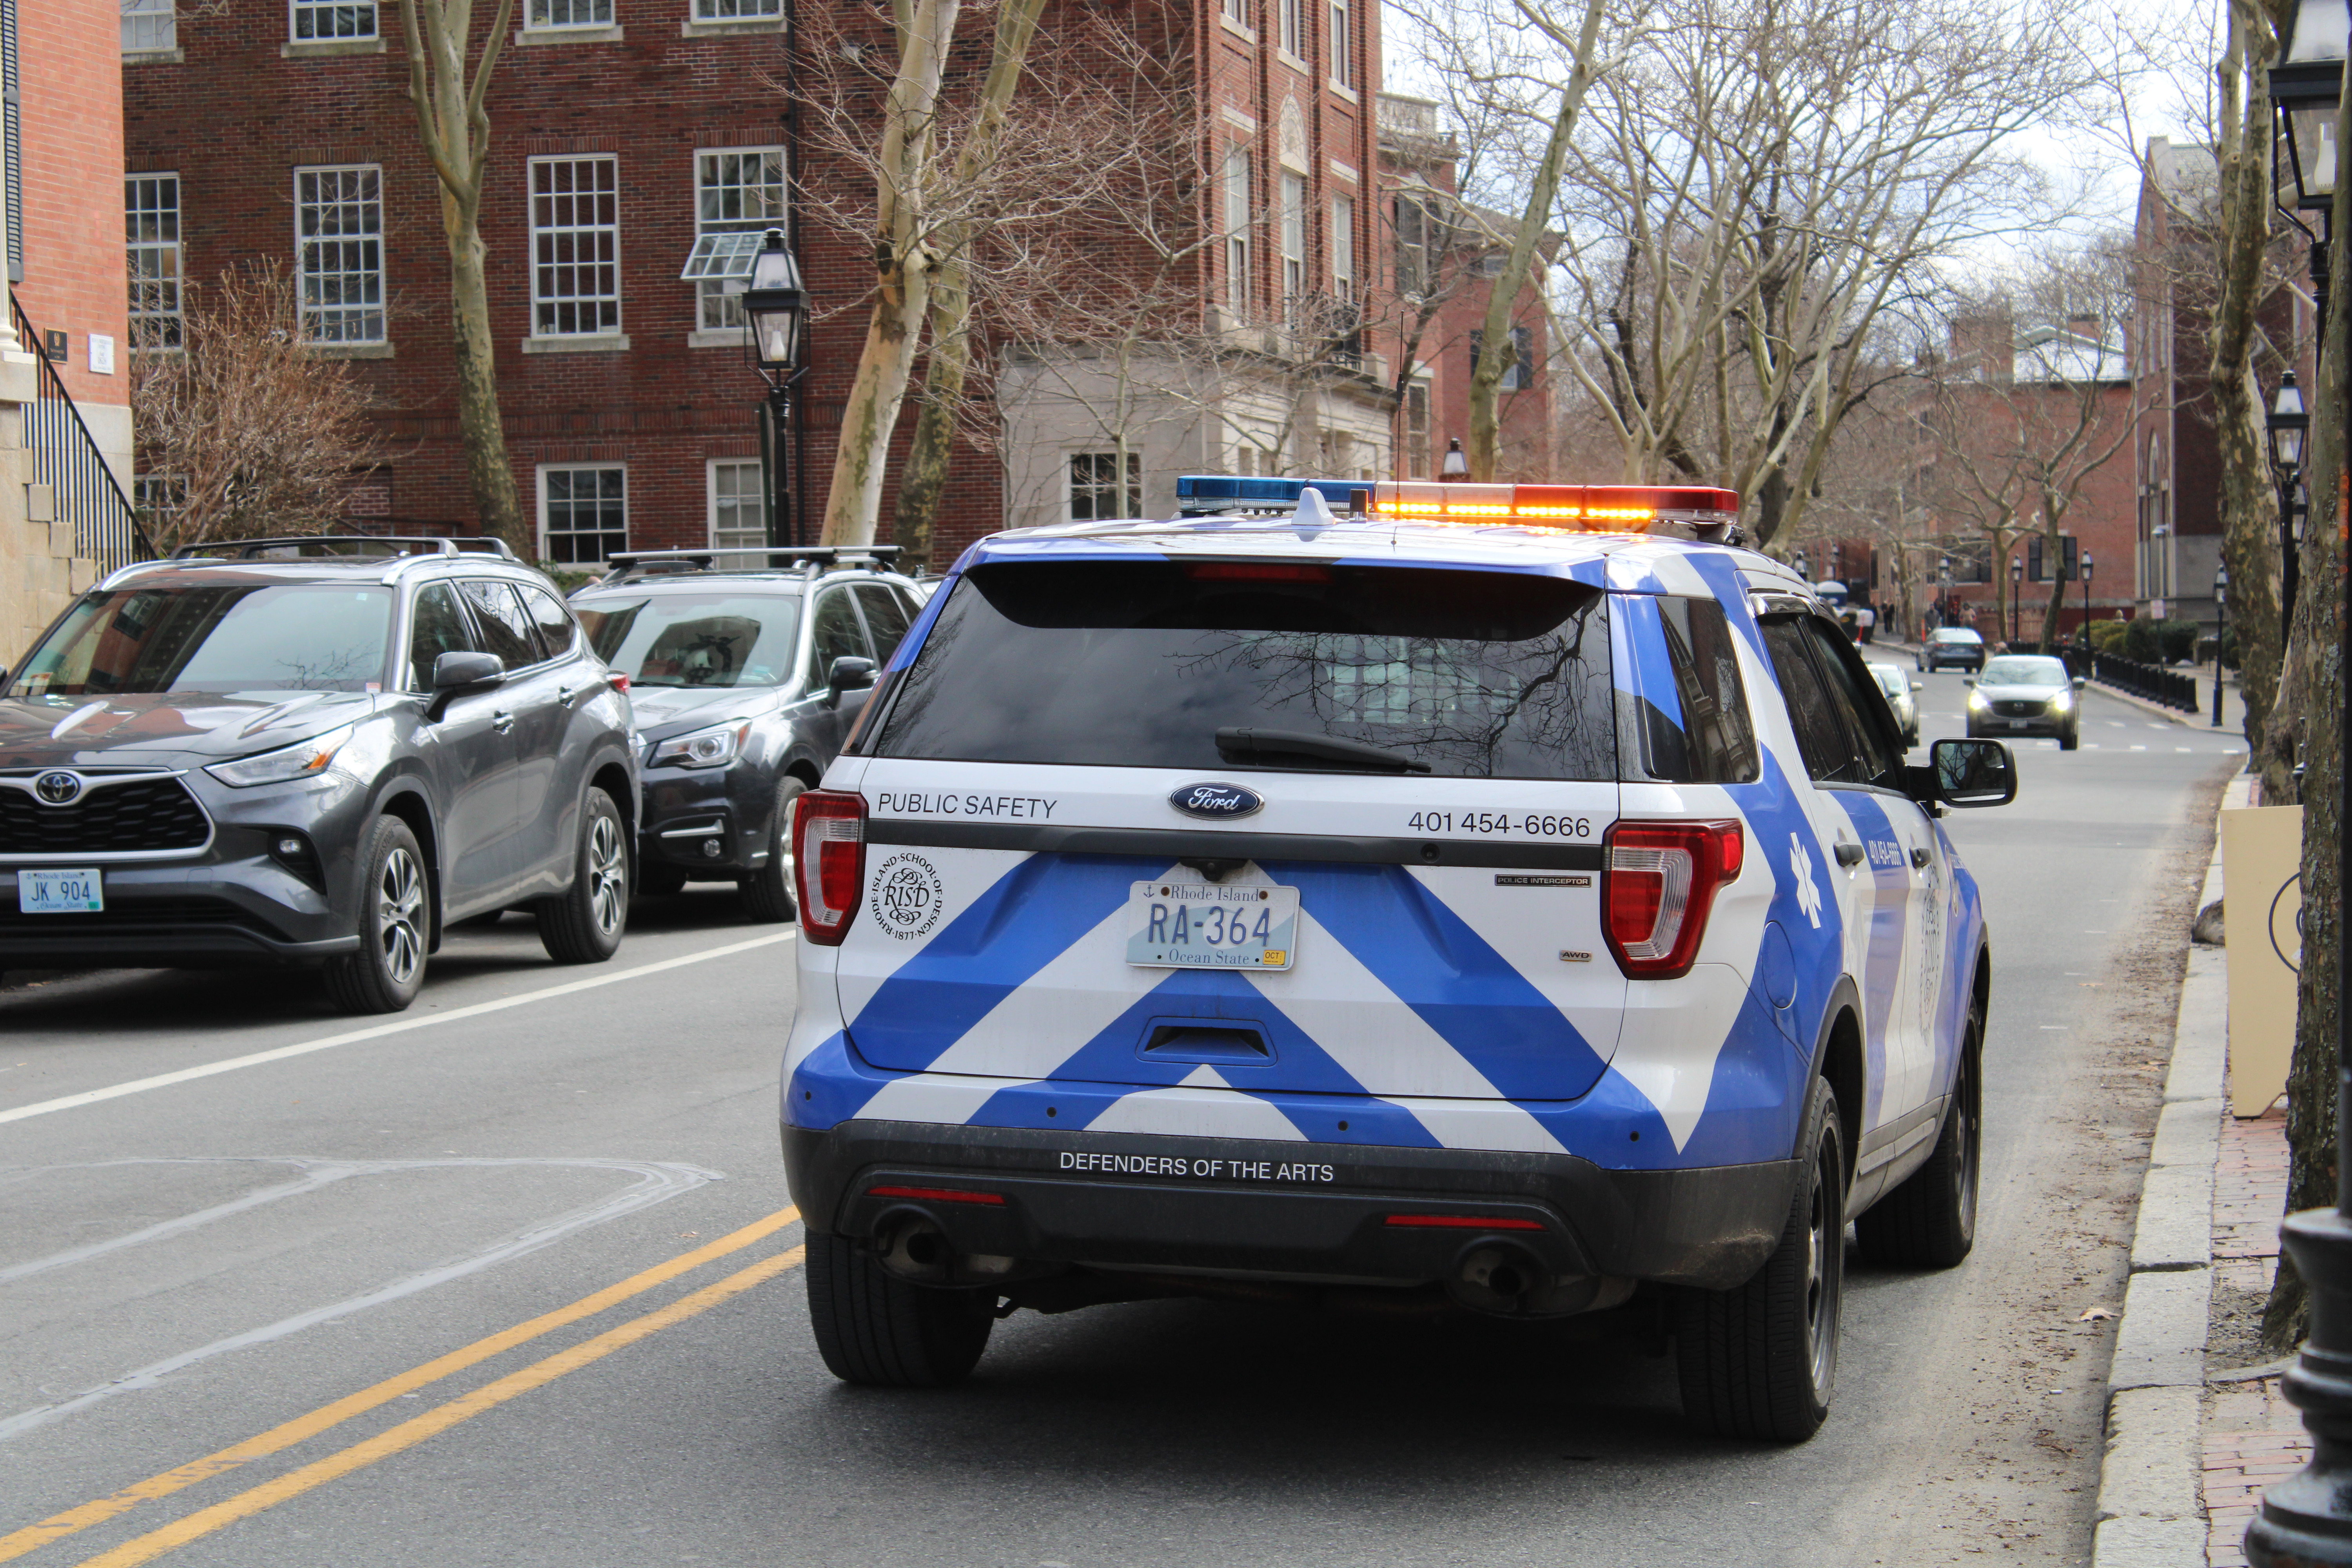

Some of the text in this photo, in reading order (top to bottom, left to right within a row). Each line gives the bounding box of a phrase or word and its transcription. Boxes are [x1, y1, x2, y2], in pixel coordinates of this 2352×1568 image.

[878, 793, 1057, 818] PUBLIC SAFETY
[1187, 786, 1241, 811] Ford
[1408, 812, 1590, 837] 401 454-6666
[31, 881, 90, 901] JK 904
[871, 853, 942, 940] RHODE ISLAND SCHOOL OF DESIGN 1877
[883, 881, 929, 913] RISD
[1171, 885, 1259, 902] Rhode Island
[1148, 904, 1270, 946] RA-364
[1169, 949, 1249, 965] Ocean State
[1060, 1152, 1334, 1181] DEFENDERS OF THE ARTS
